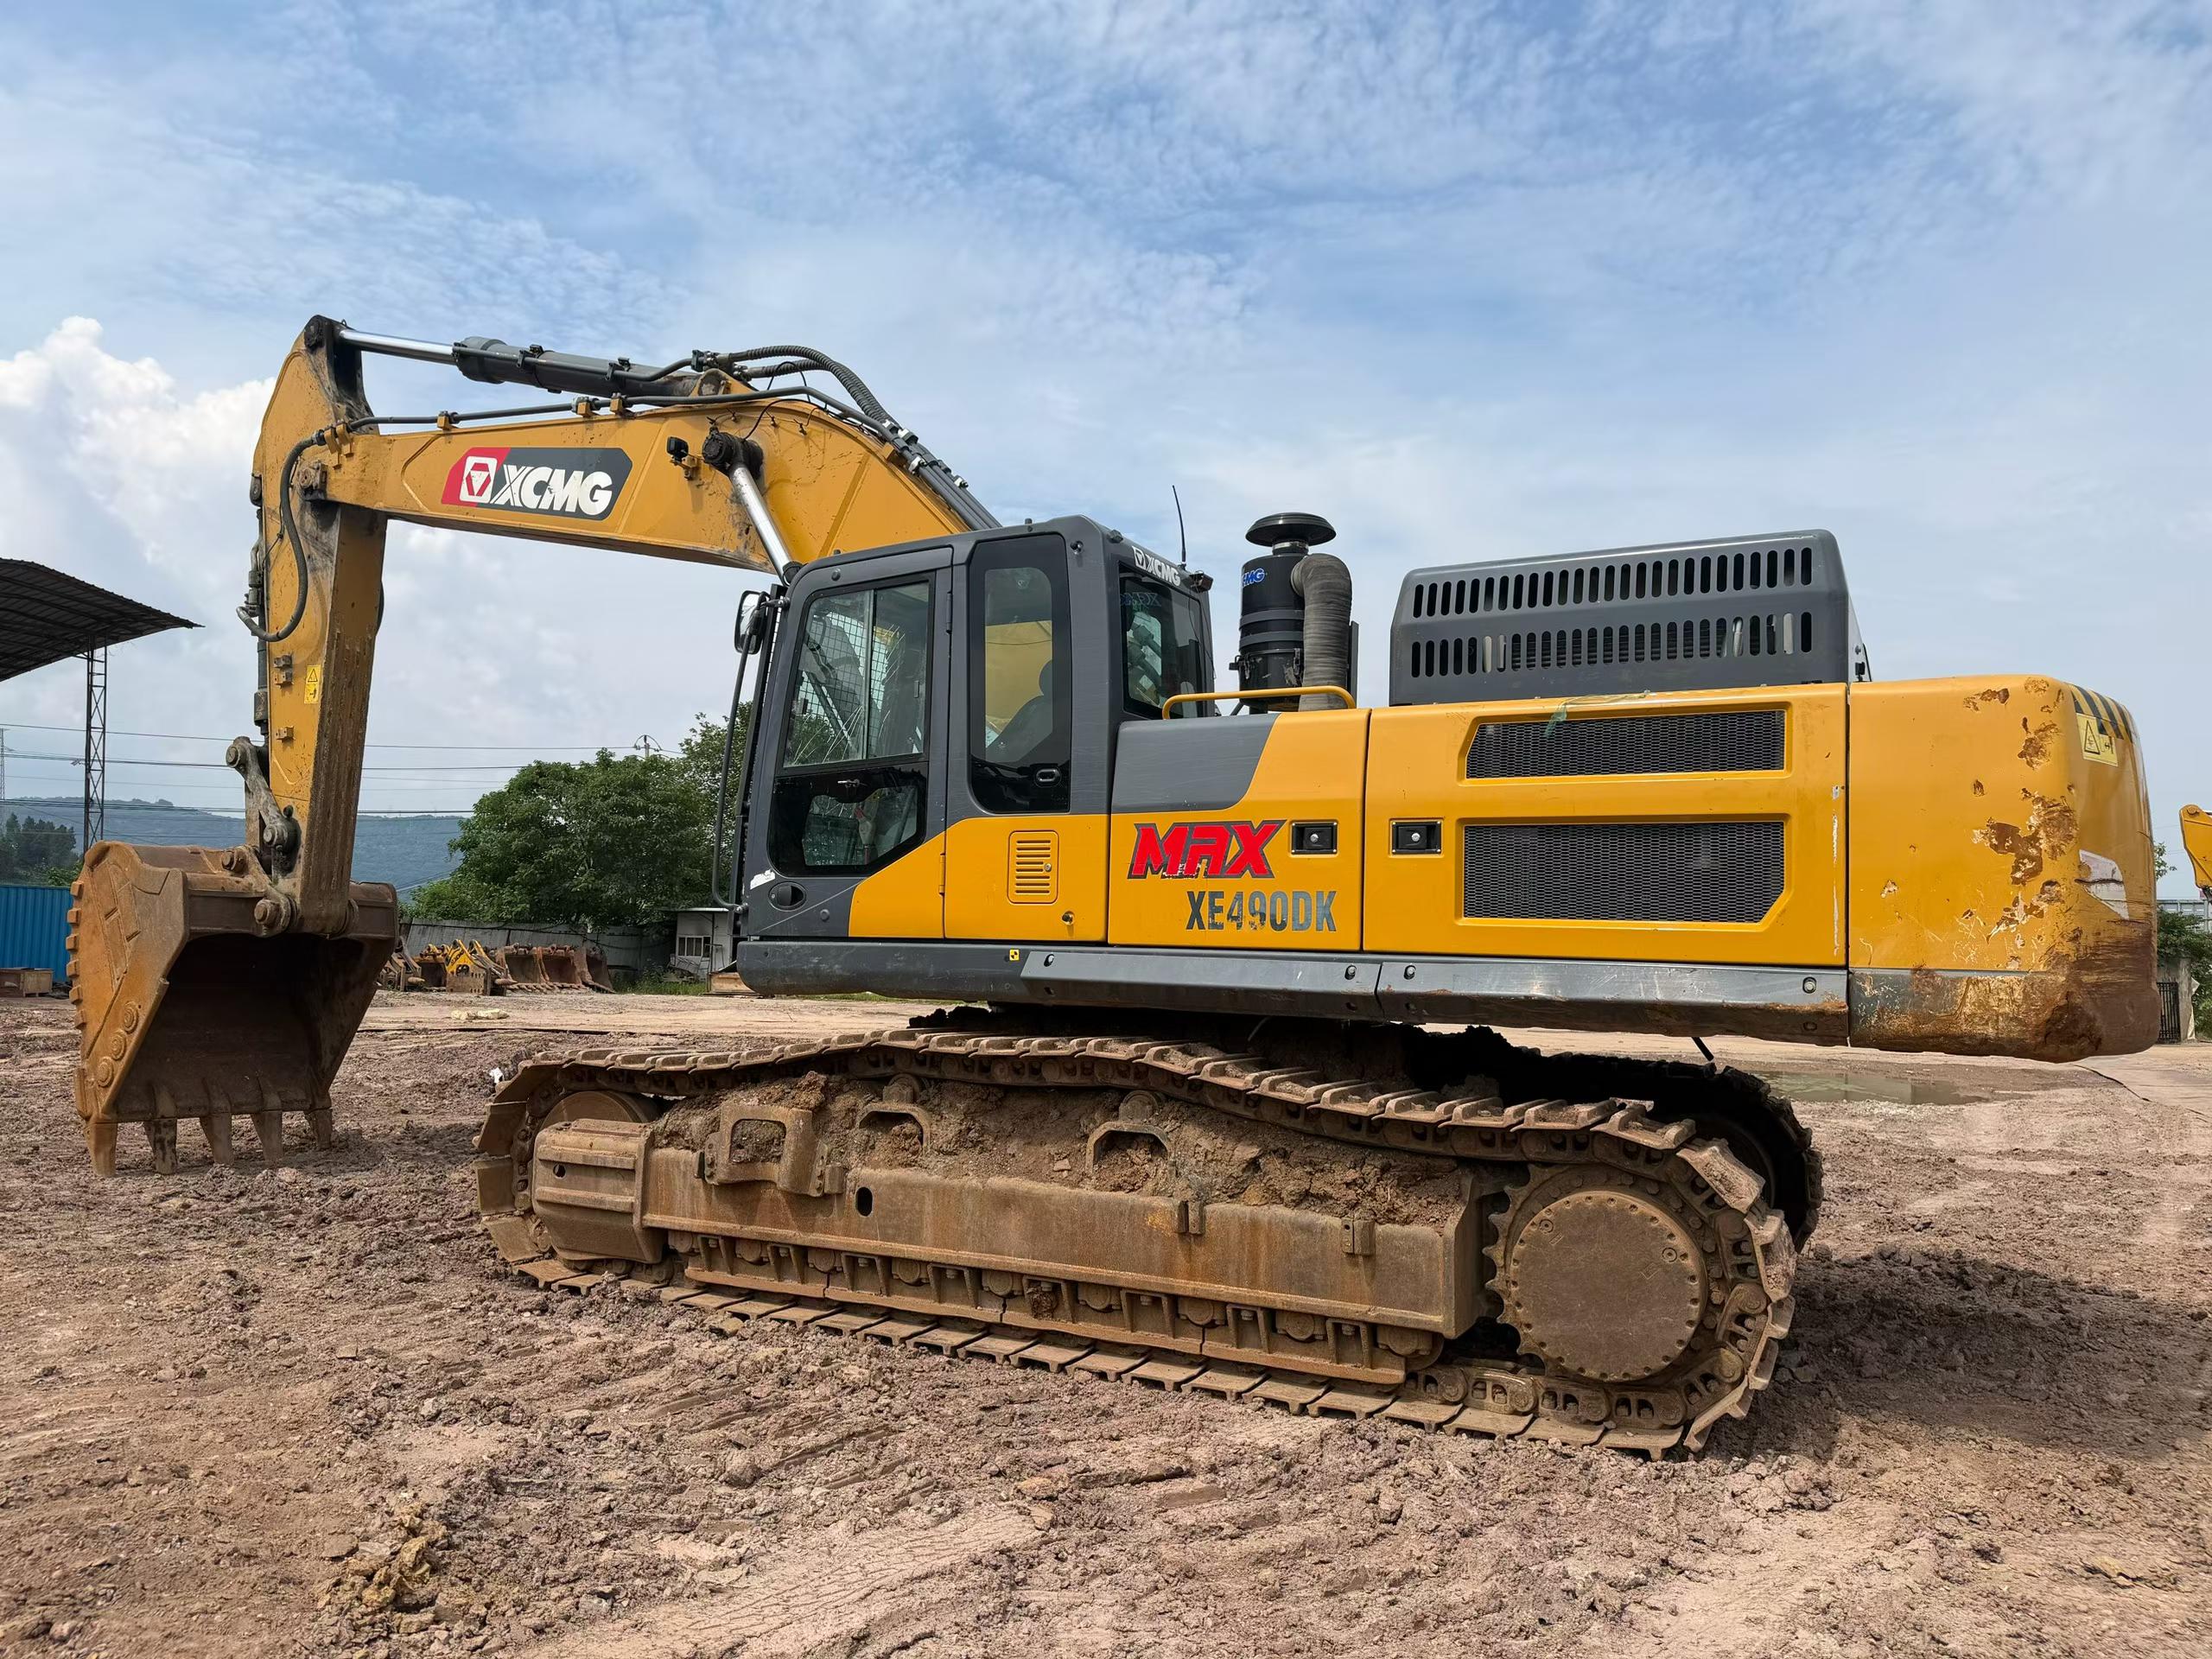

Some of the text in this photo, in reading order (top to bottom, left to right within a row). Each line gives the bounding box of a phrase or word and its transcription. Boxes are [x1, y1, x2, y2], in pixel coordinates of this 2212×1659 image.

[490, 463, 613, 516] XCMG
[1145, 553, 1181, 587] XCMG
[1127, 819, 1287, 880] MAX
[1185, 890, 1338, 932] XE490DK
